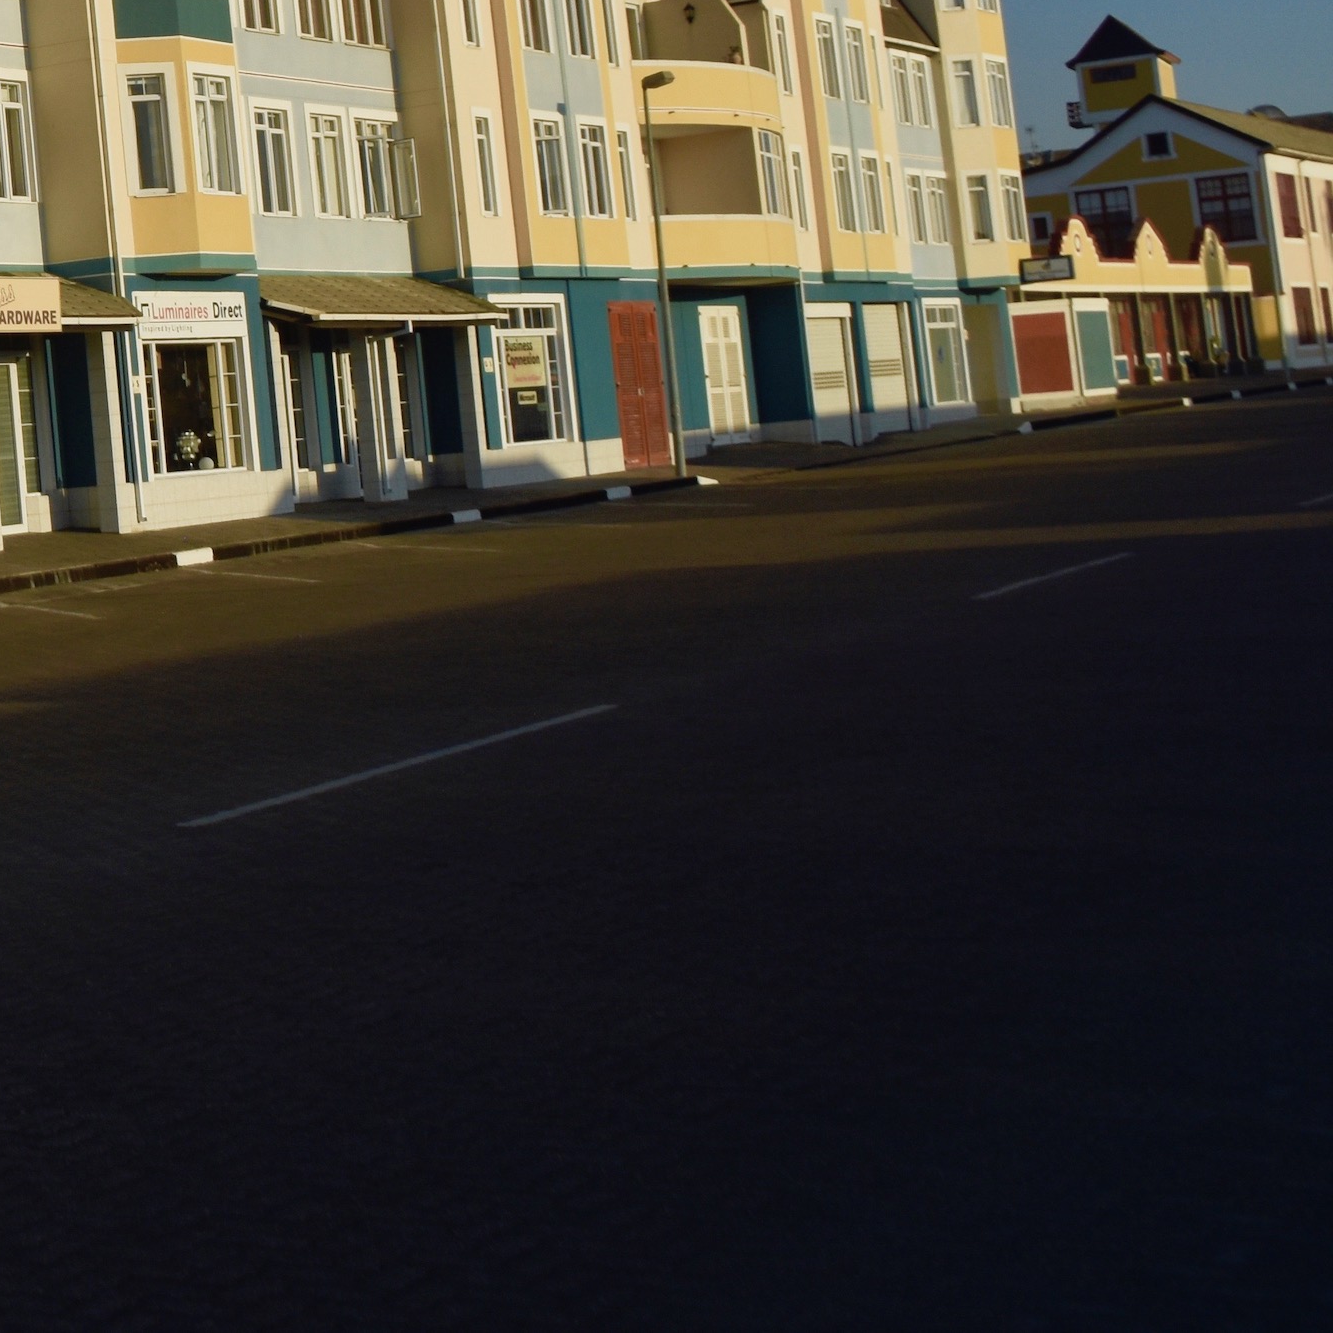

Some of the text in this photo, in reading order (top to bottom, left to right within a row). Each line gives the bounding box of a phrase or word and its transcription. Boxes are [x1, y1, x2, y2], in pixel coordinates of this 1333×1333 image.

[152, 301, 242, 320] Luminaires Direct
[504, 339, 533, 352] Business
